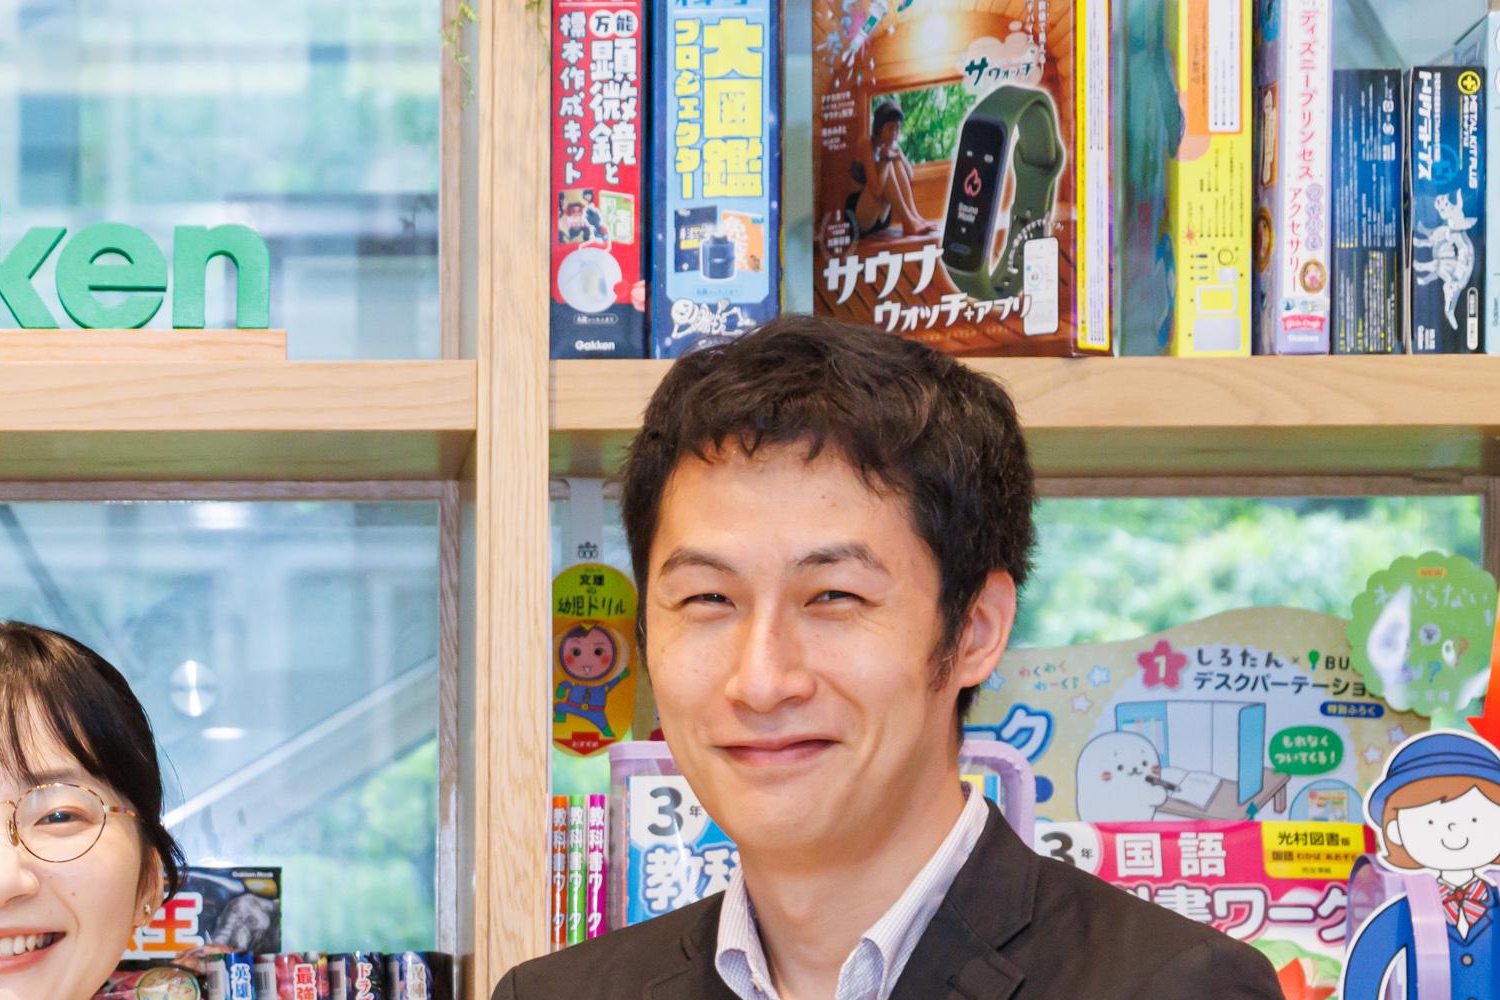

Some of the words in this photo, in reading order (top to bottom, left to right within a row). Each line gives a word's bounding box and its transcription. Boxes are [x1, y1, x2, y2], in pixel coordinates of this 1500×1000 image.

[559, 11, 586, 185] 標本作成キット
[673, 18, 701, 200] プロジェクター
[702, 17, 764, 199] 大図鑑
[1297, 10, 1318, 180] ディズニープリンセス
[824, 244, 943, 304] サウナ
[575, 340, 616, 352] Gakken
[557, 596, 626, 617] 幼児ドリル
[1194, 671, 1375, 698] デスクパーテーショ
[1197, 647, 1284, 669] しろたん
[1281, 734, 1329, 749] もれなく
[587, 804, 606, 932] 教科書ワーク
[1114, 832, 1228, 878] 国語
[1125, 884, 1348, 944] 書ワーク
